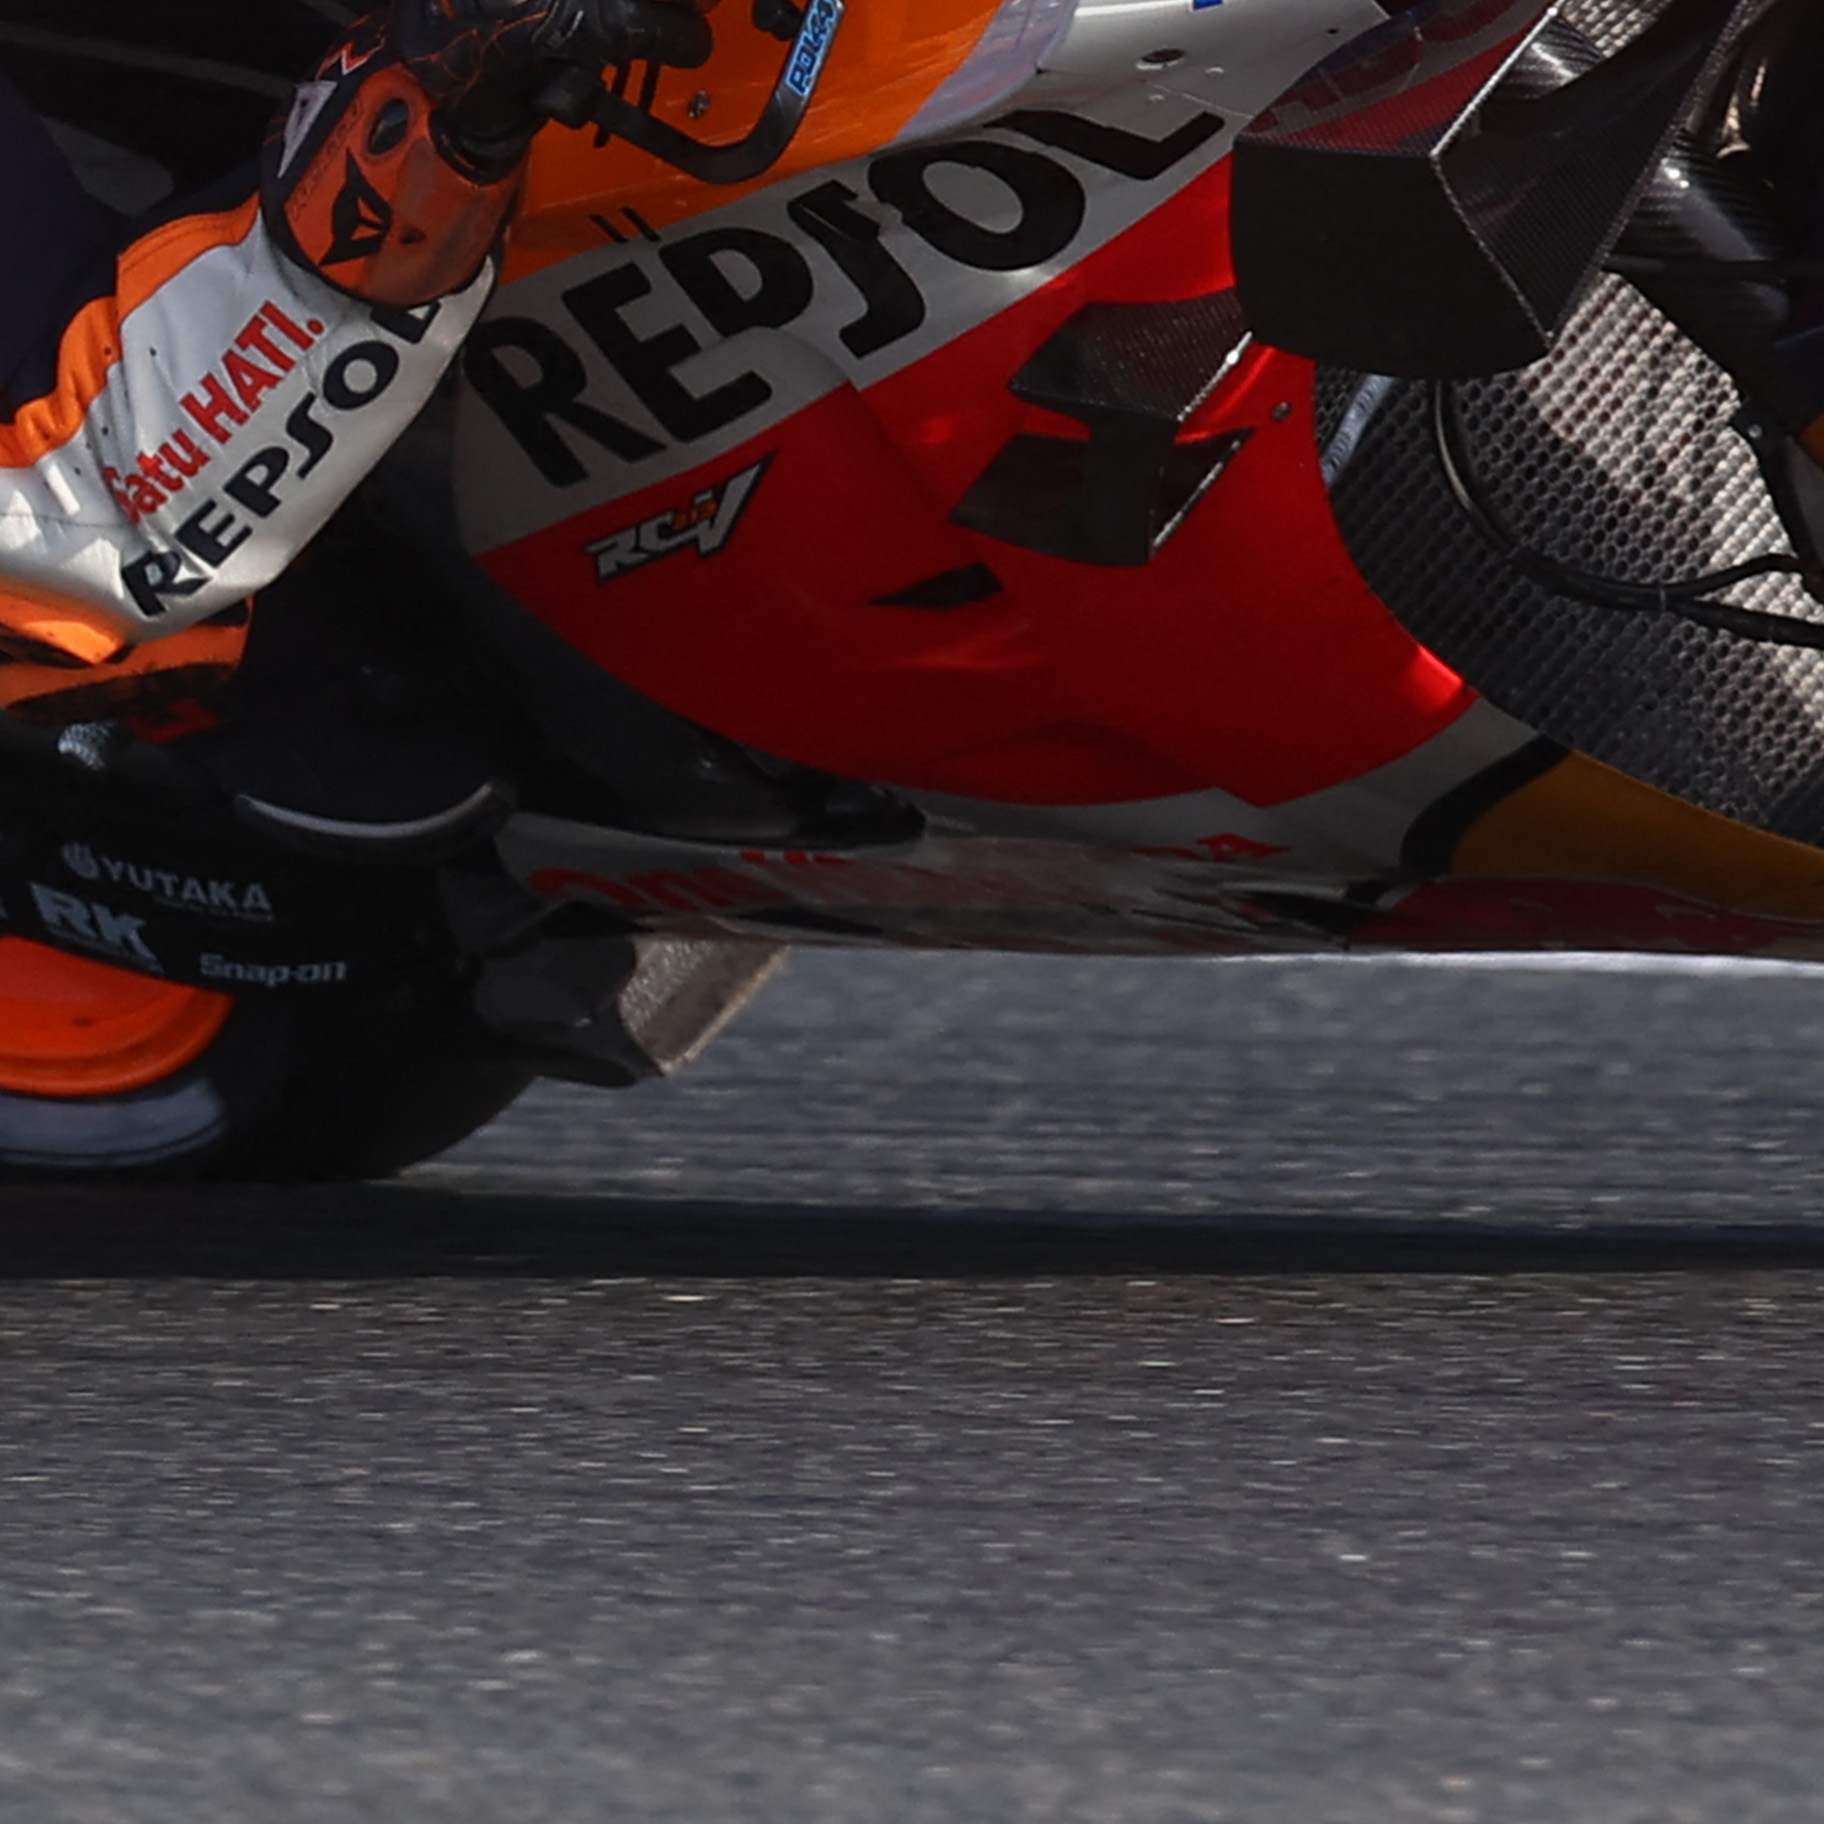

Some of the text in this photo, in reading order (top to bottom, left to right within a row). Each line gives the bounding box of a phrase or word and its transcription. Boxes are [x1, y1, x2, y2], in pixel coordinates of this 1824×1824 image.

[462, 107, 1226, 488] REPSOL
[179, 300, 327, 445] HATI.
[119, 299, 442, 618] REPSOL
[28, 880, 166, 976] RK
[101, 855, 274, 913] YUTAKA
[199, 951, 348, 989] Snap-on
